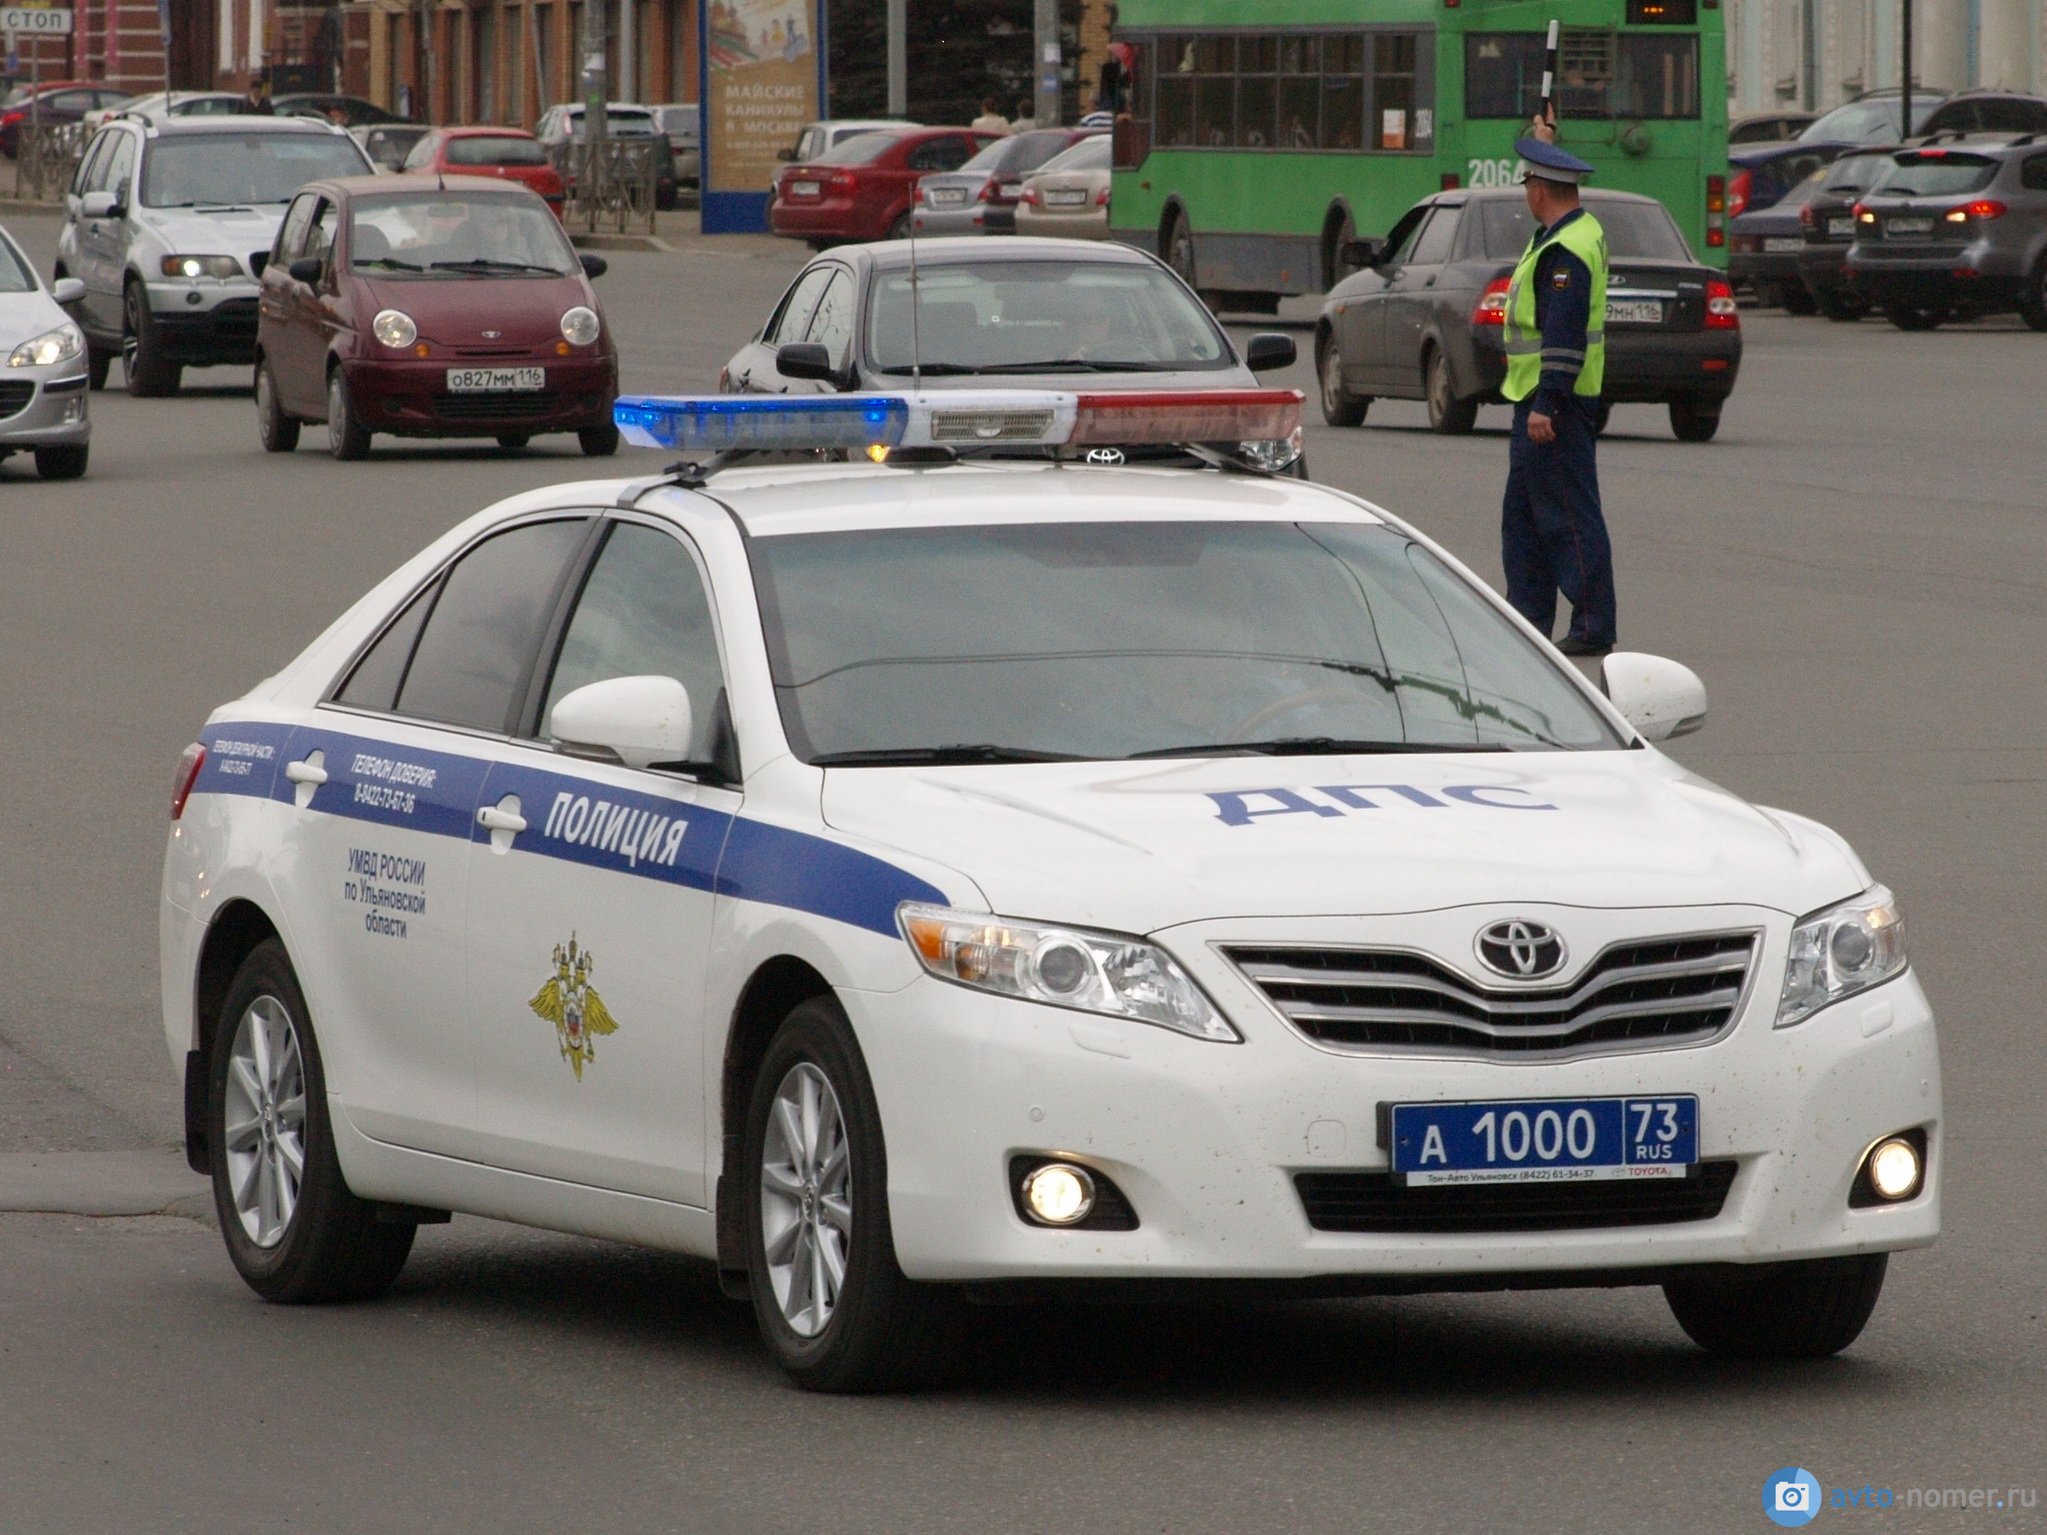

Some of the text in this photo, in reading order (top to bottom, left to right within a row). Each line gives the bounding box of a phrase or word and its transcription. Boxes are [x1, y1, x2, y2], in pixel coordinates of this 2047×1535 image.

[7, 11, 62, 28] СТОП
[726, 83, 805, 99] МАЙСКИЕ
[726, 103, 805, 117] КАНИКУЛЫ
[1468, 158, 1527, 188] 2064
[518, 368, 542, 381] 116
[351, 753, 437, 789] ТЕЛЕФОН ДОВЕРИЯ:
[1203, 784, 1560, 827] ДПС
[543, 791, 689, 868] ПОЛИЦИЯ
[347, 847, 426, 887] УМВД РОССИИ
[344, 878, 426, 915] по Ульяновской
[365, 908, 407, 939] области
[1419, 1102, 1679, 1165] А 1000 73
[1636, 1144, 1673, 1161] RUS
[1471, 1172, 1518, 1182] Ульяновск
[1520, 1170, 1551, 1181] (8422)
[1552, 1169, 1595, 1179] 61-34-37
[1628, 1167, 1668, 1177] TOYOTA
